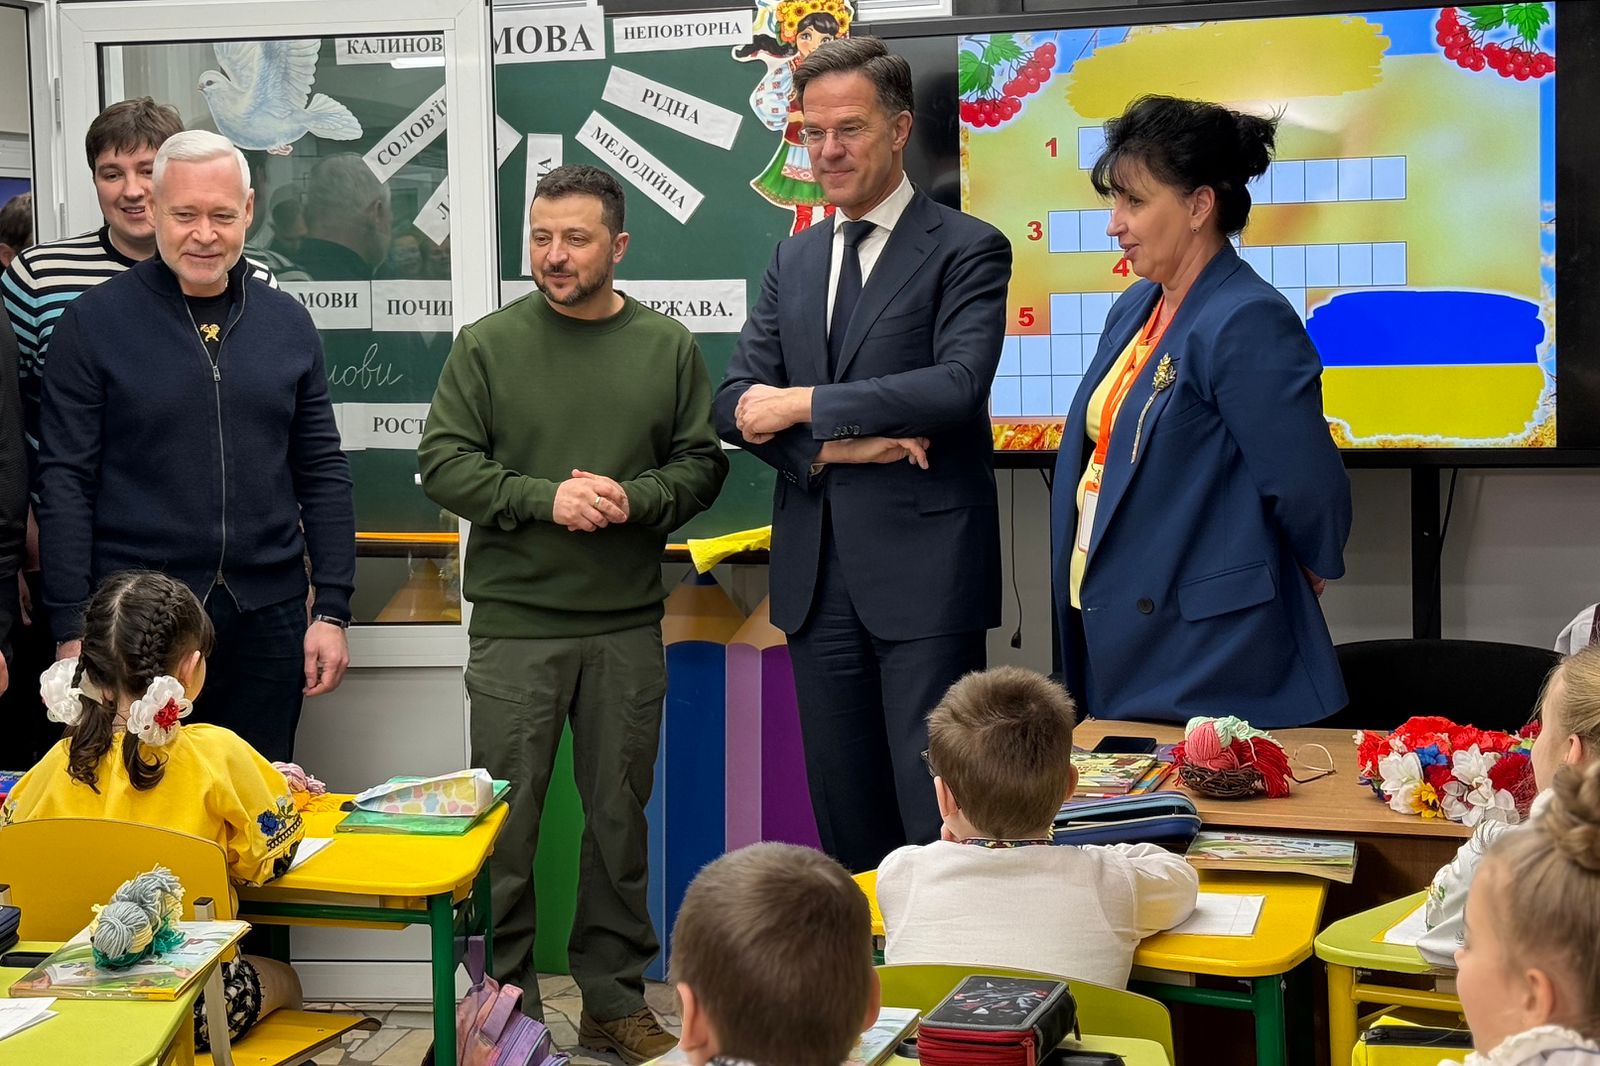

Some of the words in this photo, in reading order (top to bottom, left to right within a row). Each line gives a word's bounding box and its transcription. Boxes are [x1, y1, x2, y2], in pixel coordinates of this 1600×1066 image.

[624, 22, 742, 40] НЕПОВТОРНА
[640, 88, 700, 126] РІДНА
[1045, 137, 1057, 157] 1
[590, 126, 687, 210] МЕЛОДІЙНА
[1027, 221, 1043, 241] 3
[1112, 257, 1130, 277] 4
[299, 292, 358, 308] МОВИ
[1018, 307, 1034, 327] 5
